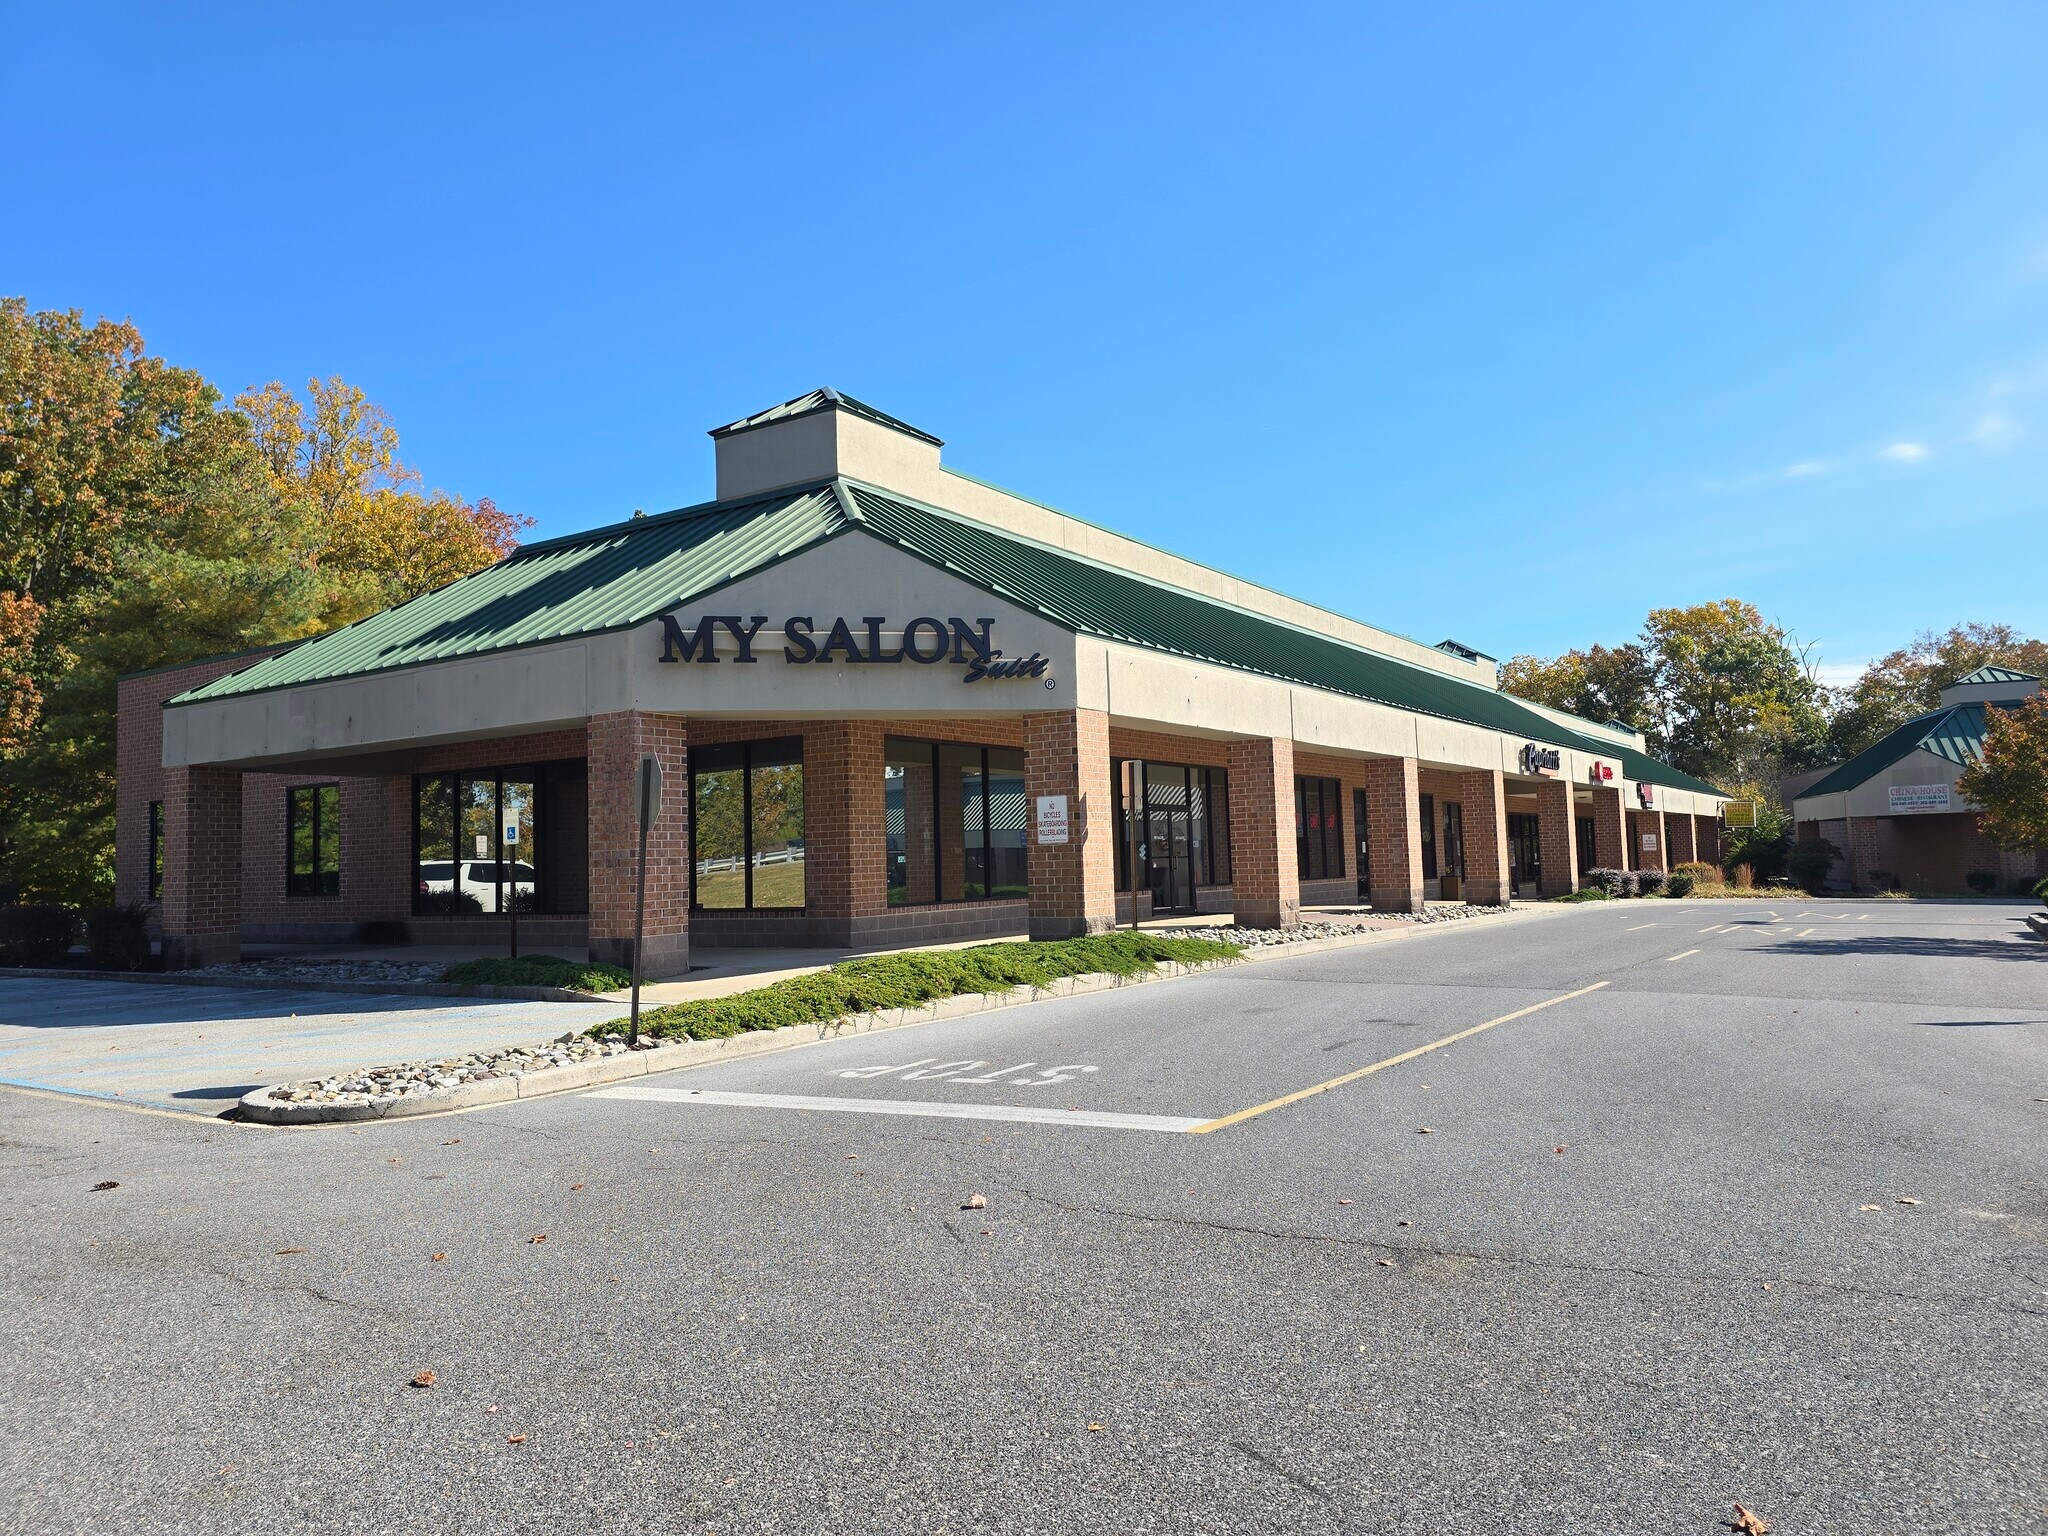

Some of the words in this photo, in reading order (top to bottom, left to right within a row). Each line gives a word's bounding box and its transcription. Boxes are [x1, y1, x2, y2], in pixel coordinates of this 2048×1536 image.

[658, 616, 768, 663] MY
[783, 617, 995, 664] SALON
[963, 649, 1050, 683] Suite
[1891, 788, 1917, 796] CHINA
[1920, 787, 1948, 795] HOUSE
[832, 1058, 1099, 1086] STOP
